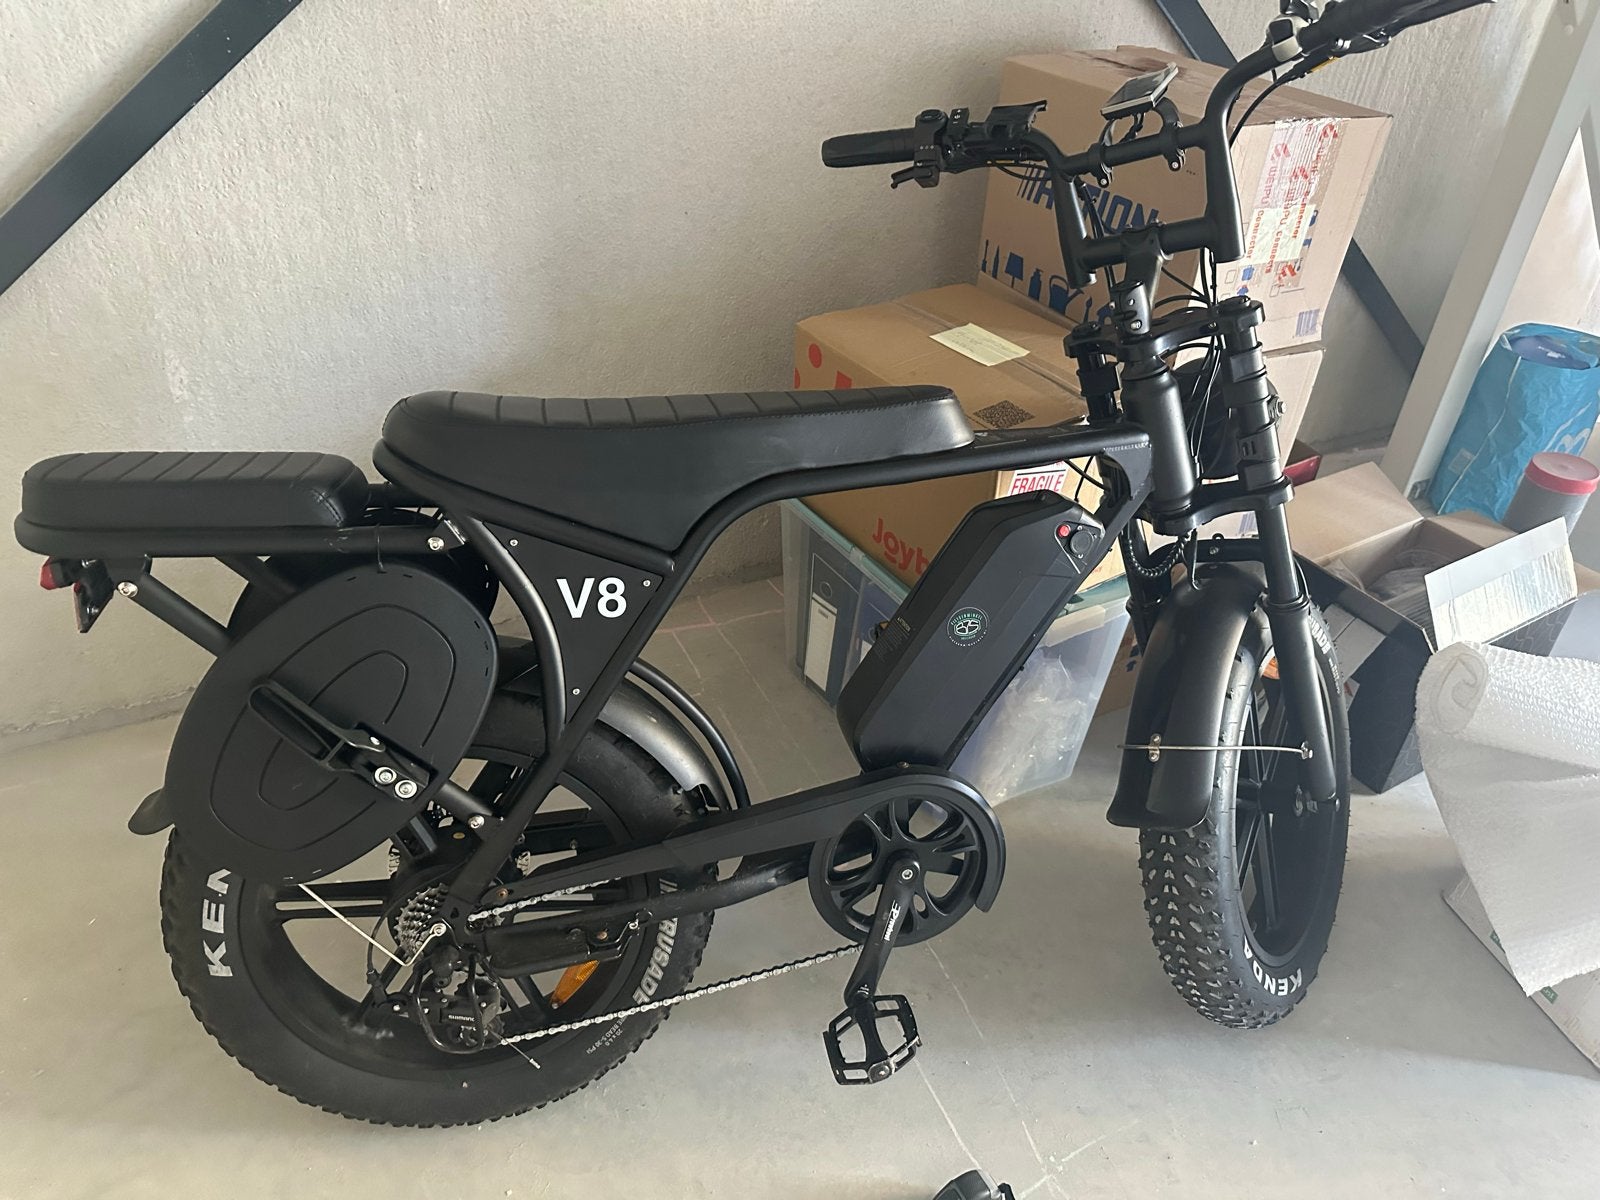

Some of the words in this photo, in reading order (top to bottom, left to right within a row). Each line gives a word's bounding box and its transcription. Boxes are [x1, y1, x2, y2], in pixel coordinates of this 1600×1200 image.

[1011, 474, 1064, 495] FRAGILE
[556, 577, 627, 619] V8
[633, 878, 679, 1005] RUSADE
[1243, 935, 1303, 996] KENDA
